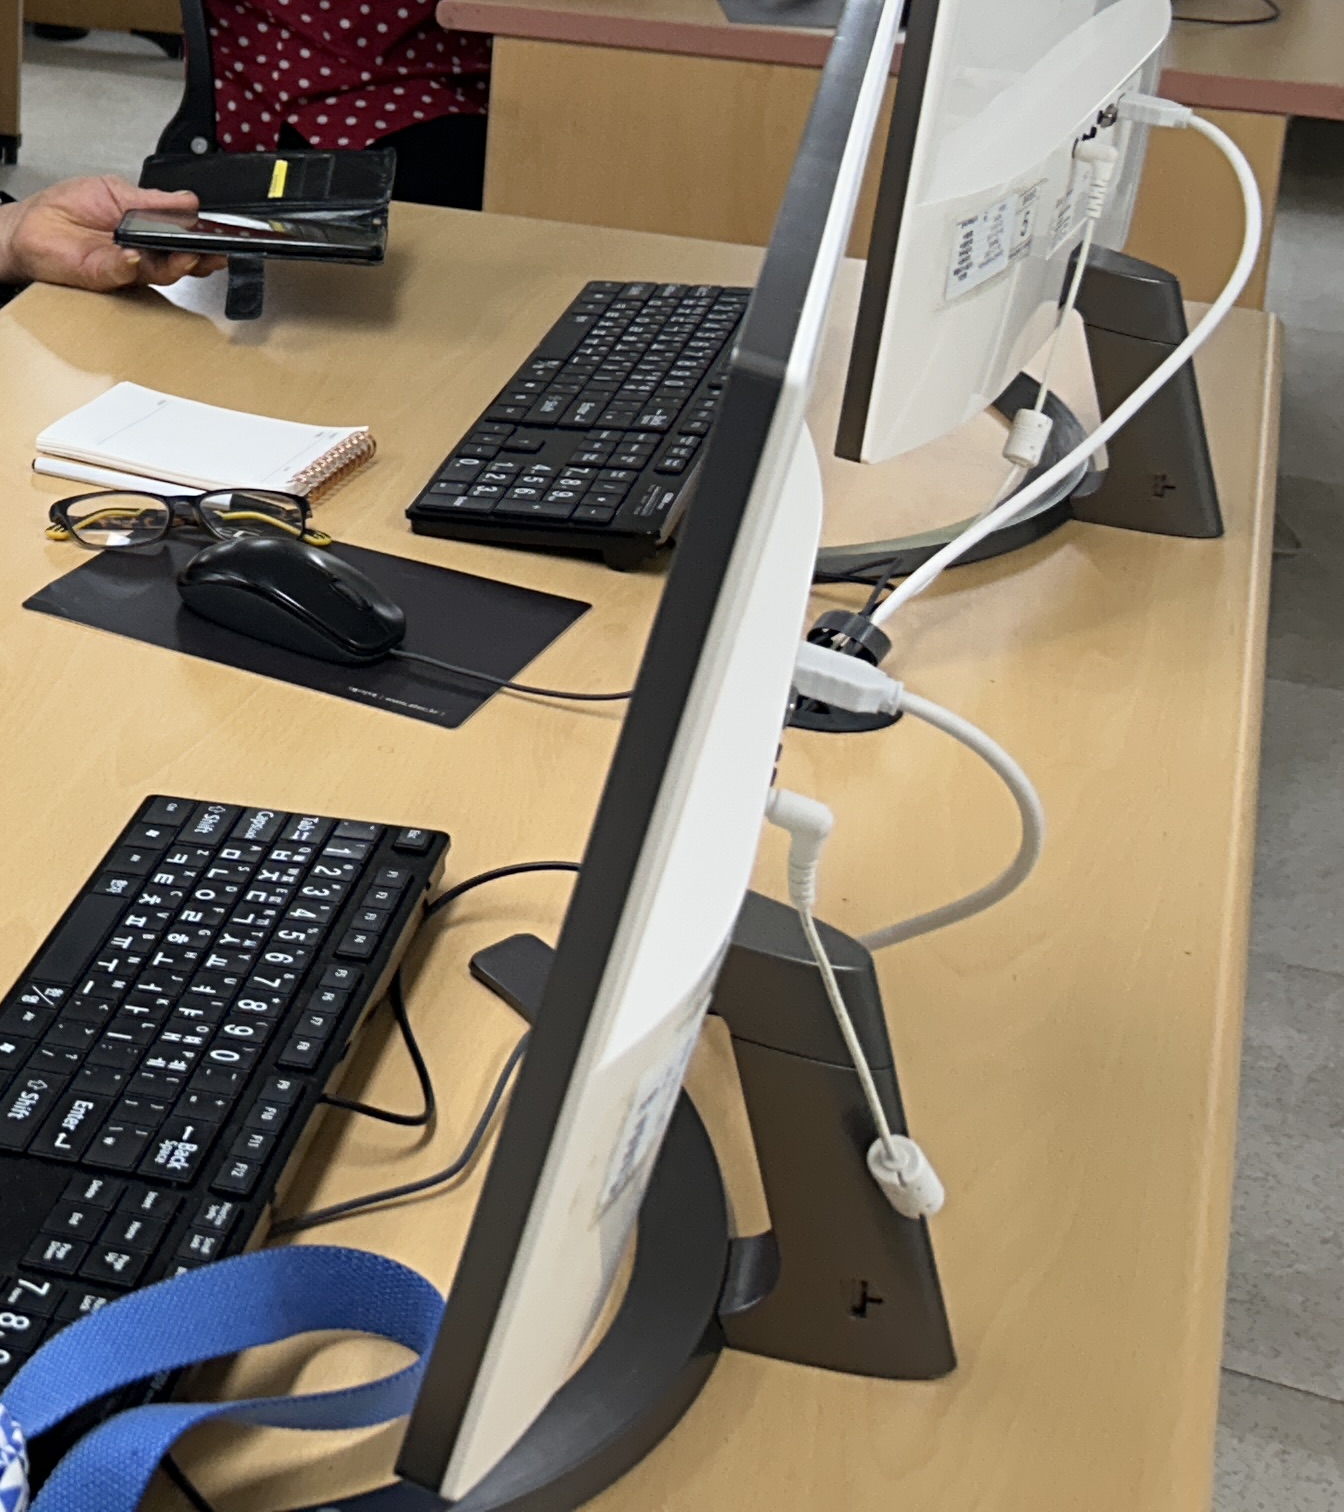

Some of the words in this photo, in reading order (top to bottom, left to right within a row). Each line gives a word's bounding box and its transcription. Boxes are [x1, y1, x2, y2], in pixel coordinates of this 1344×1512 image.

[475, 486, 497, 494] 3
[550, 491, 573, 499] 9
[194, 813, 220, 834] Shift
[302, 818, 318, 831] Tab
[167, 854, 188, 863] ㅋ
[221, 849, 241, 859] ㅁ
[271, 850, 291, 860] ㅂ
[208, 869, 228, 877] ㄴ
[258, 870, 279, 881] ㅈ
[314, 866, 341, 875] 2
[154, 874, 174, 884] ㅌ
[195, 890, 215, 899] ㅇ
[246, 891, 267, 901] ㄷ
[303, 887, 329, 896] 3
[139, 894, 161, 904] ㅊ
[181, 910, 202, 921] ㄹ
[233, 914, 254, 923] ㄱ
[290, 909, 316, 918] 4
[125, 915, 146, 927] ㅍ
[168, 933, 189, 943] ㅎ
[220, 933, 240, 943] ㅅ
[278, 931, 305, 940] 5
[111, 937, 133, 948] ㅠ
[153, 952, 173, 965] ㅗ
[206, 954, 227, 966] ㅛ
[265, 953, 293, 963] 6
[98, 959, 118, 971] ㅜ
[335, 969, 347, 977] F5
[254, 977, 280, 987] 7
[322, 992, 334, 1000] F6
[125, 1005, 149, 1013] ㅏ
[238, 1000, 267, 1011] 8
[311, 1017, 323, 1025] F7
[224, 1025, 253, 1035] 9
[210, 1050, 239, 1061] 0
[277, 1080, 290, 1089] F9
[7, 1091, 39, 1119] Shift
[63, 1100, 93, 1131] Enter
[261, 1107, 276, 1120] F10
[248, 1135, 263, 1147] F11
[167, 1142, 197, 1168] Back
[231, 1163, 248, 1177] F12
[19, 1279, 50, 1295] 7
